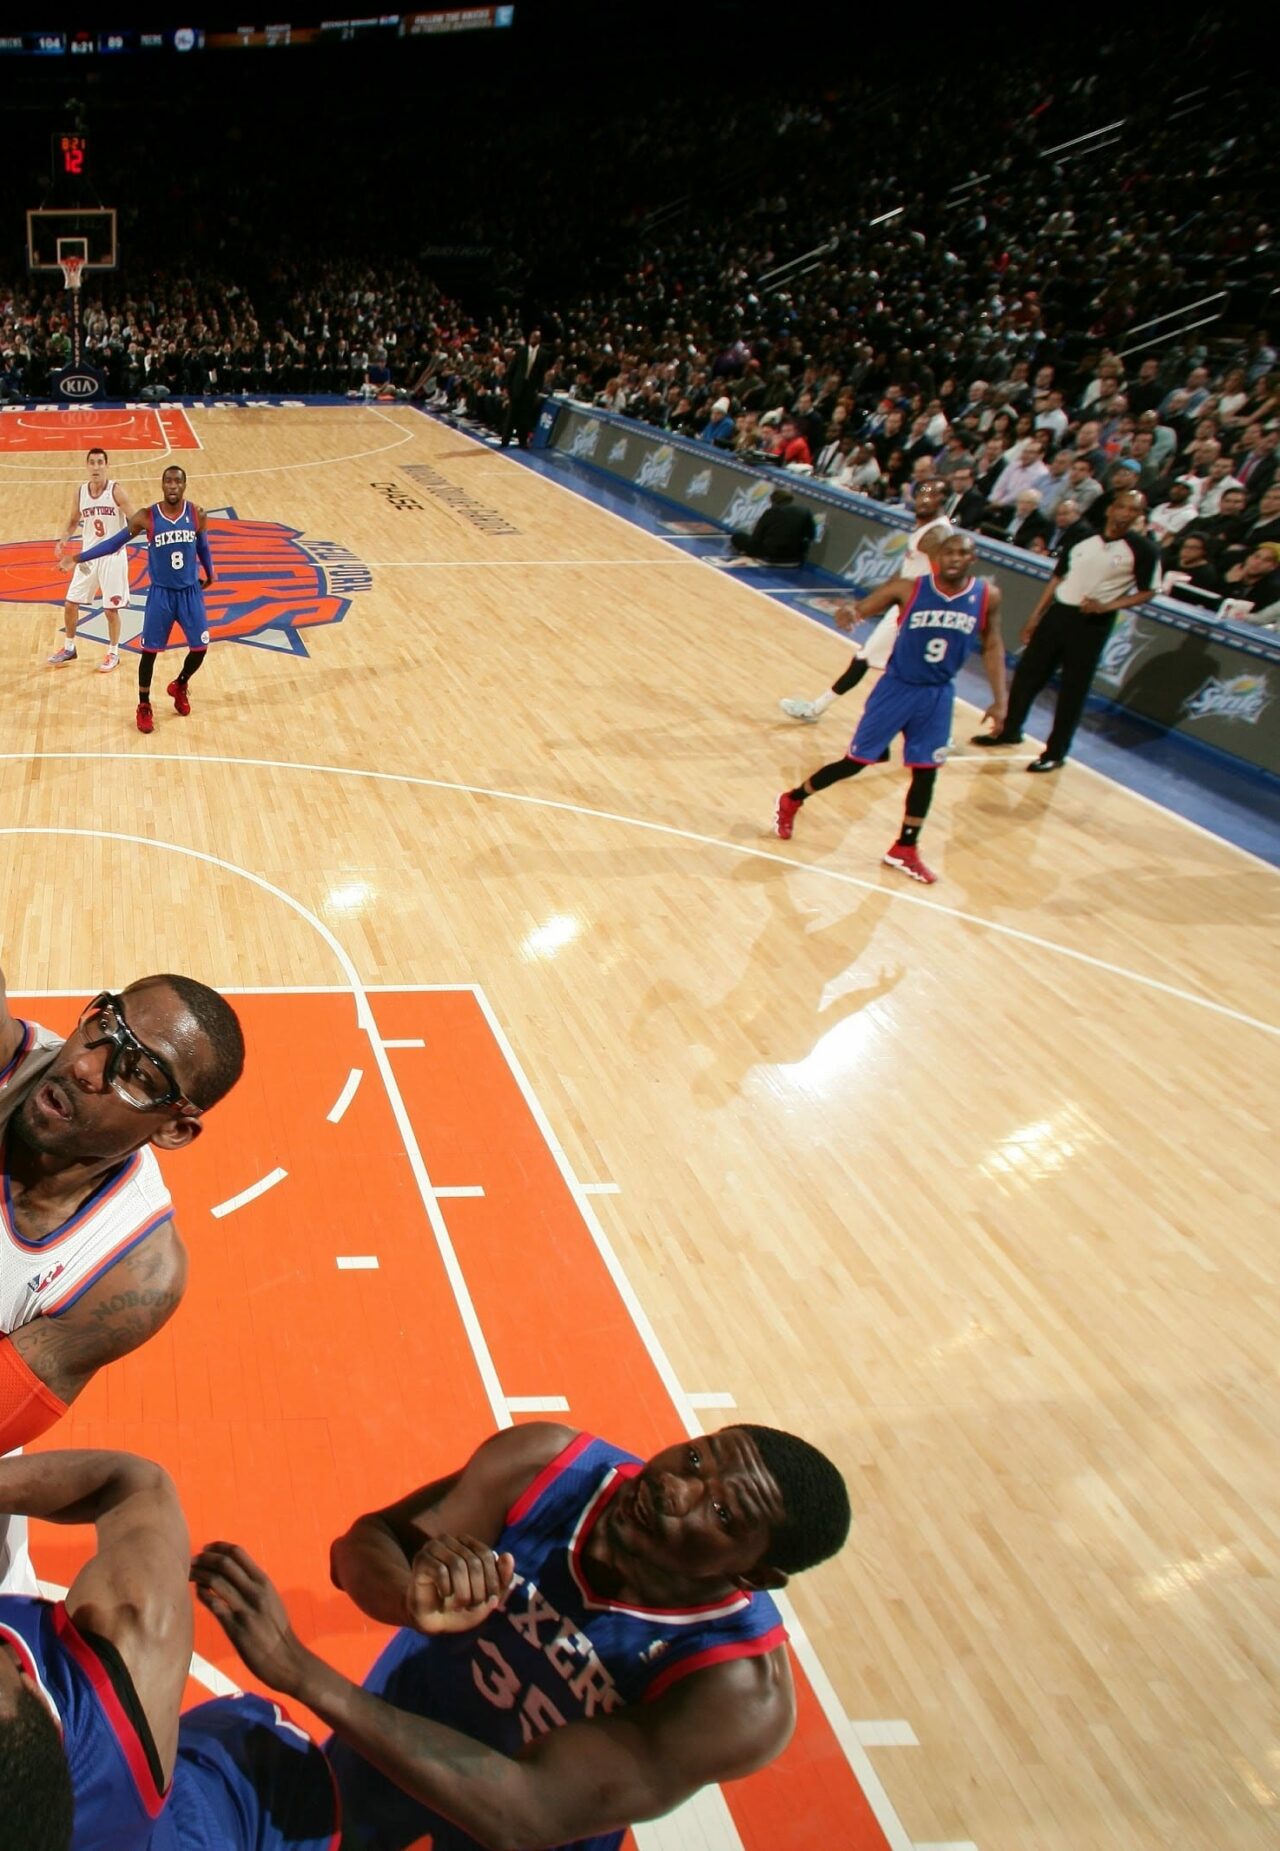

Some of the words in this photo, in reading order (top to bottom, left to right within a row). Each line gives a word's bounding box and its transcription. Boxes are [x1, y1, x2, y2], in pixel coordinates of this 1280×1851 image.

[38, 37, 62, 49] 104
[71, 41, 94, 54] 8:21
[64, 149, 83, 173] 12
[66, 380, 93, 392] KIA
[125, 400, 307, 410] KNICKS
[370, 482, 424, 510] CHASE
[93, 519, 105, 537] 9
[154, 529, 198, 548] SIXERS
[171, 551, 184, 570] 8
[909, 610, 977, 634] SIXERS
[924, 638, 948, 663] 9
[497, 1573, 626, 1719] IXER
[472, 1637, 569, 1744] 35
